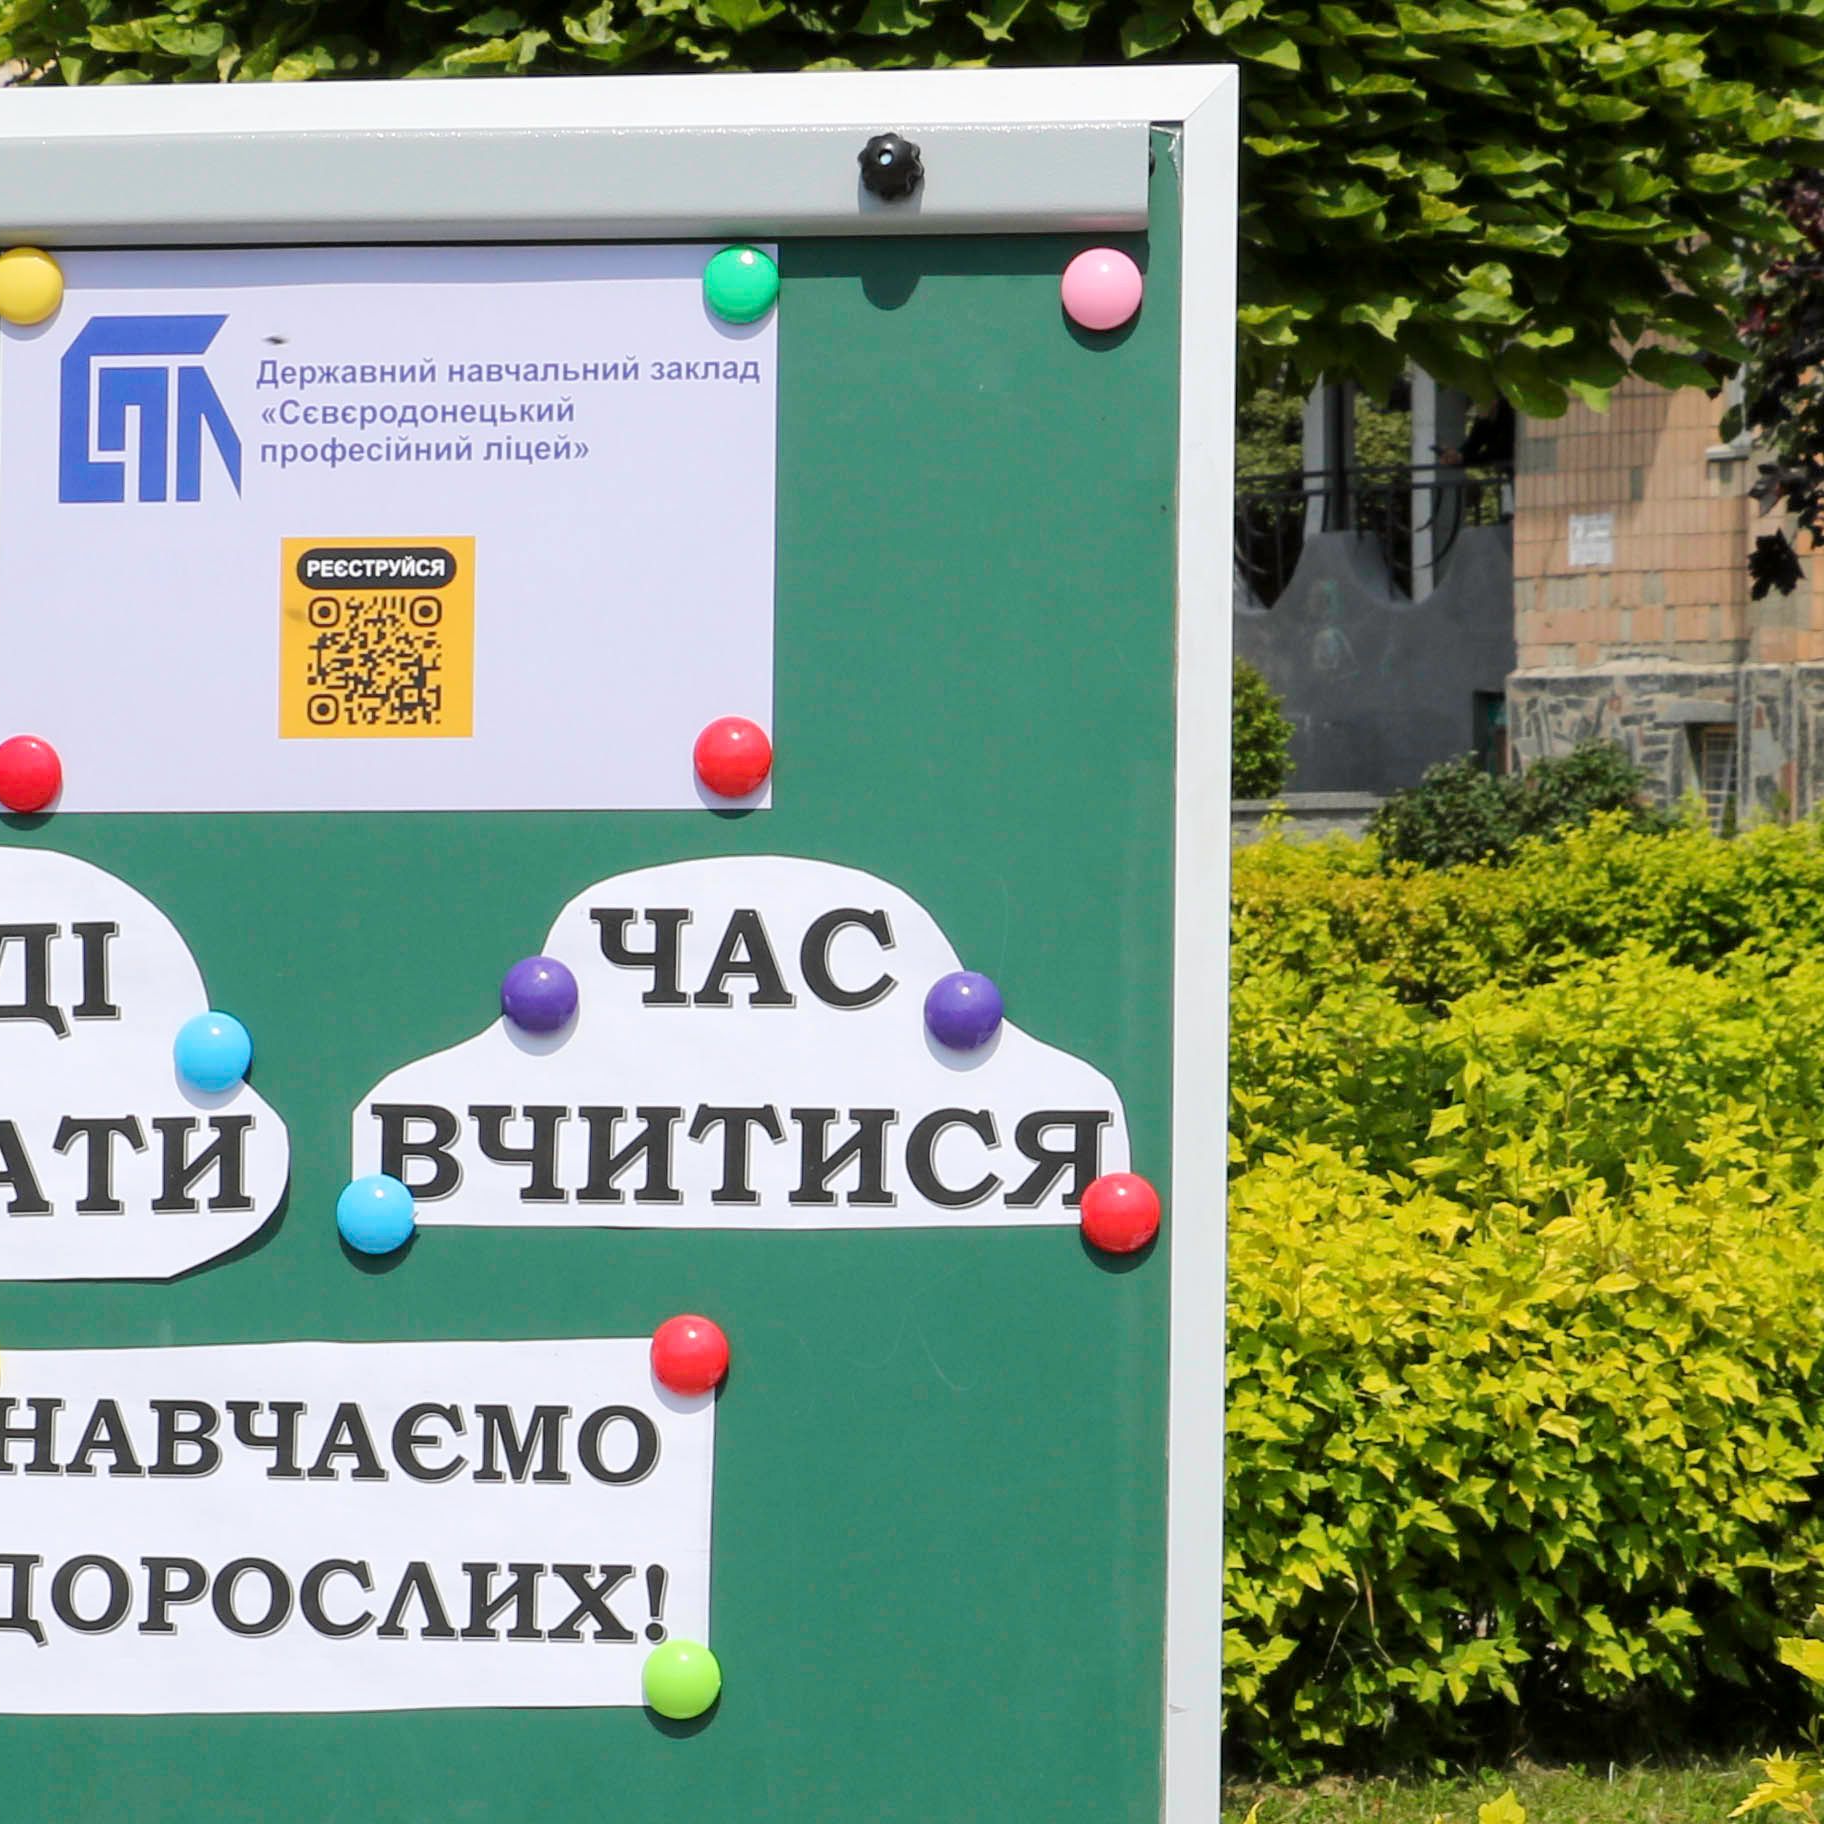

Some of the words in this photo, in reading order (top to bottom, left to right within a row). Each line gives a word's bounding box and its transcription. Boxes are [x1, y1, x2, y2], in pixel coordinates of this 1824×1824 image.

[256, 358, 436, 390] Державний
[447, 355, 640, 384] навчальний
[651, 360, 760, 386] заклад
[261, 396, 575, 429] «Сєвєродонецький
[261, 435, 473, 469] професійний
[484, 435, 590, 465] ліцей»
[306, 555, 446, 580] РЕЄСТРУЙСЯ
[589, 907, 897, 1011] ЧАС
[371, 1100, 1110, 1211] ВЧИТИСЯ
